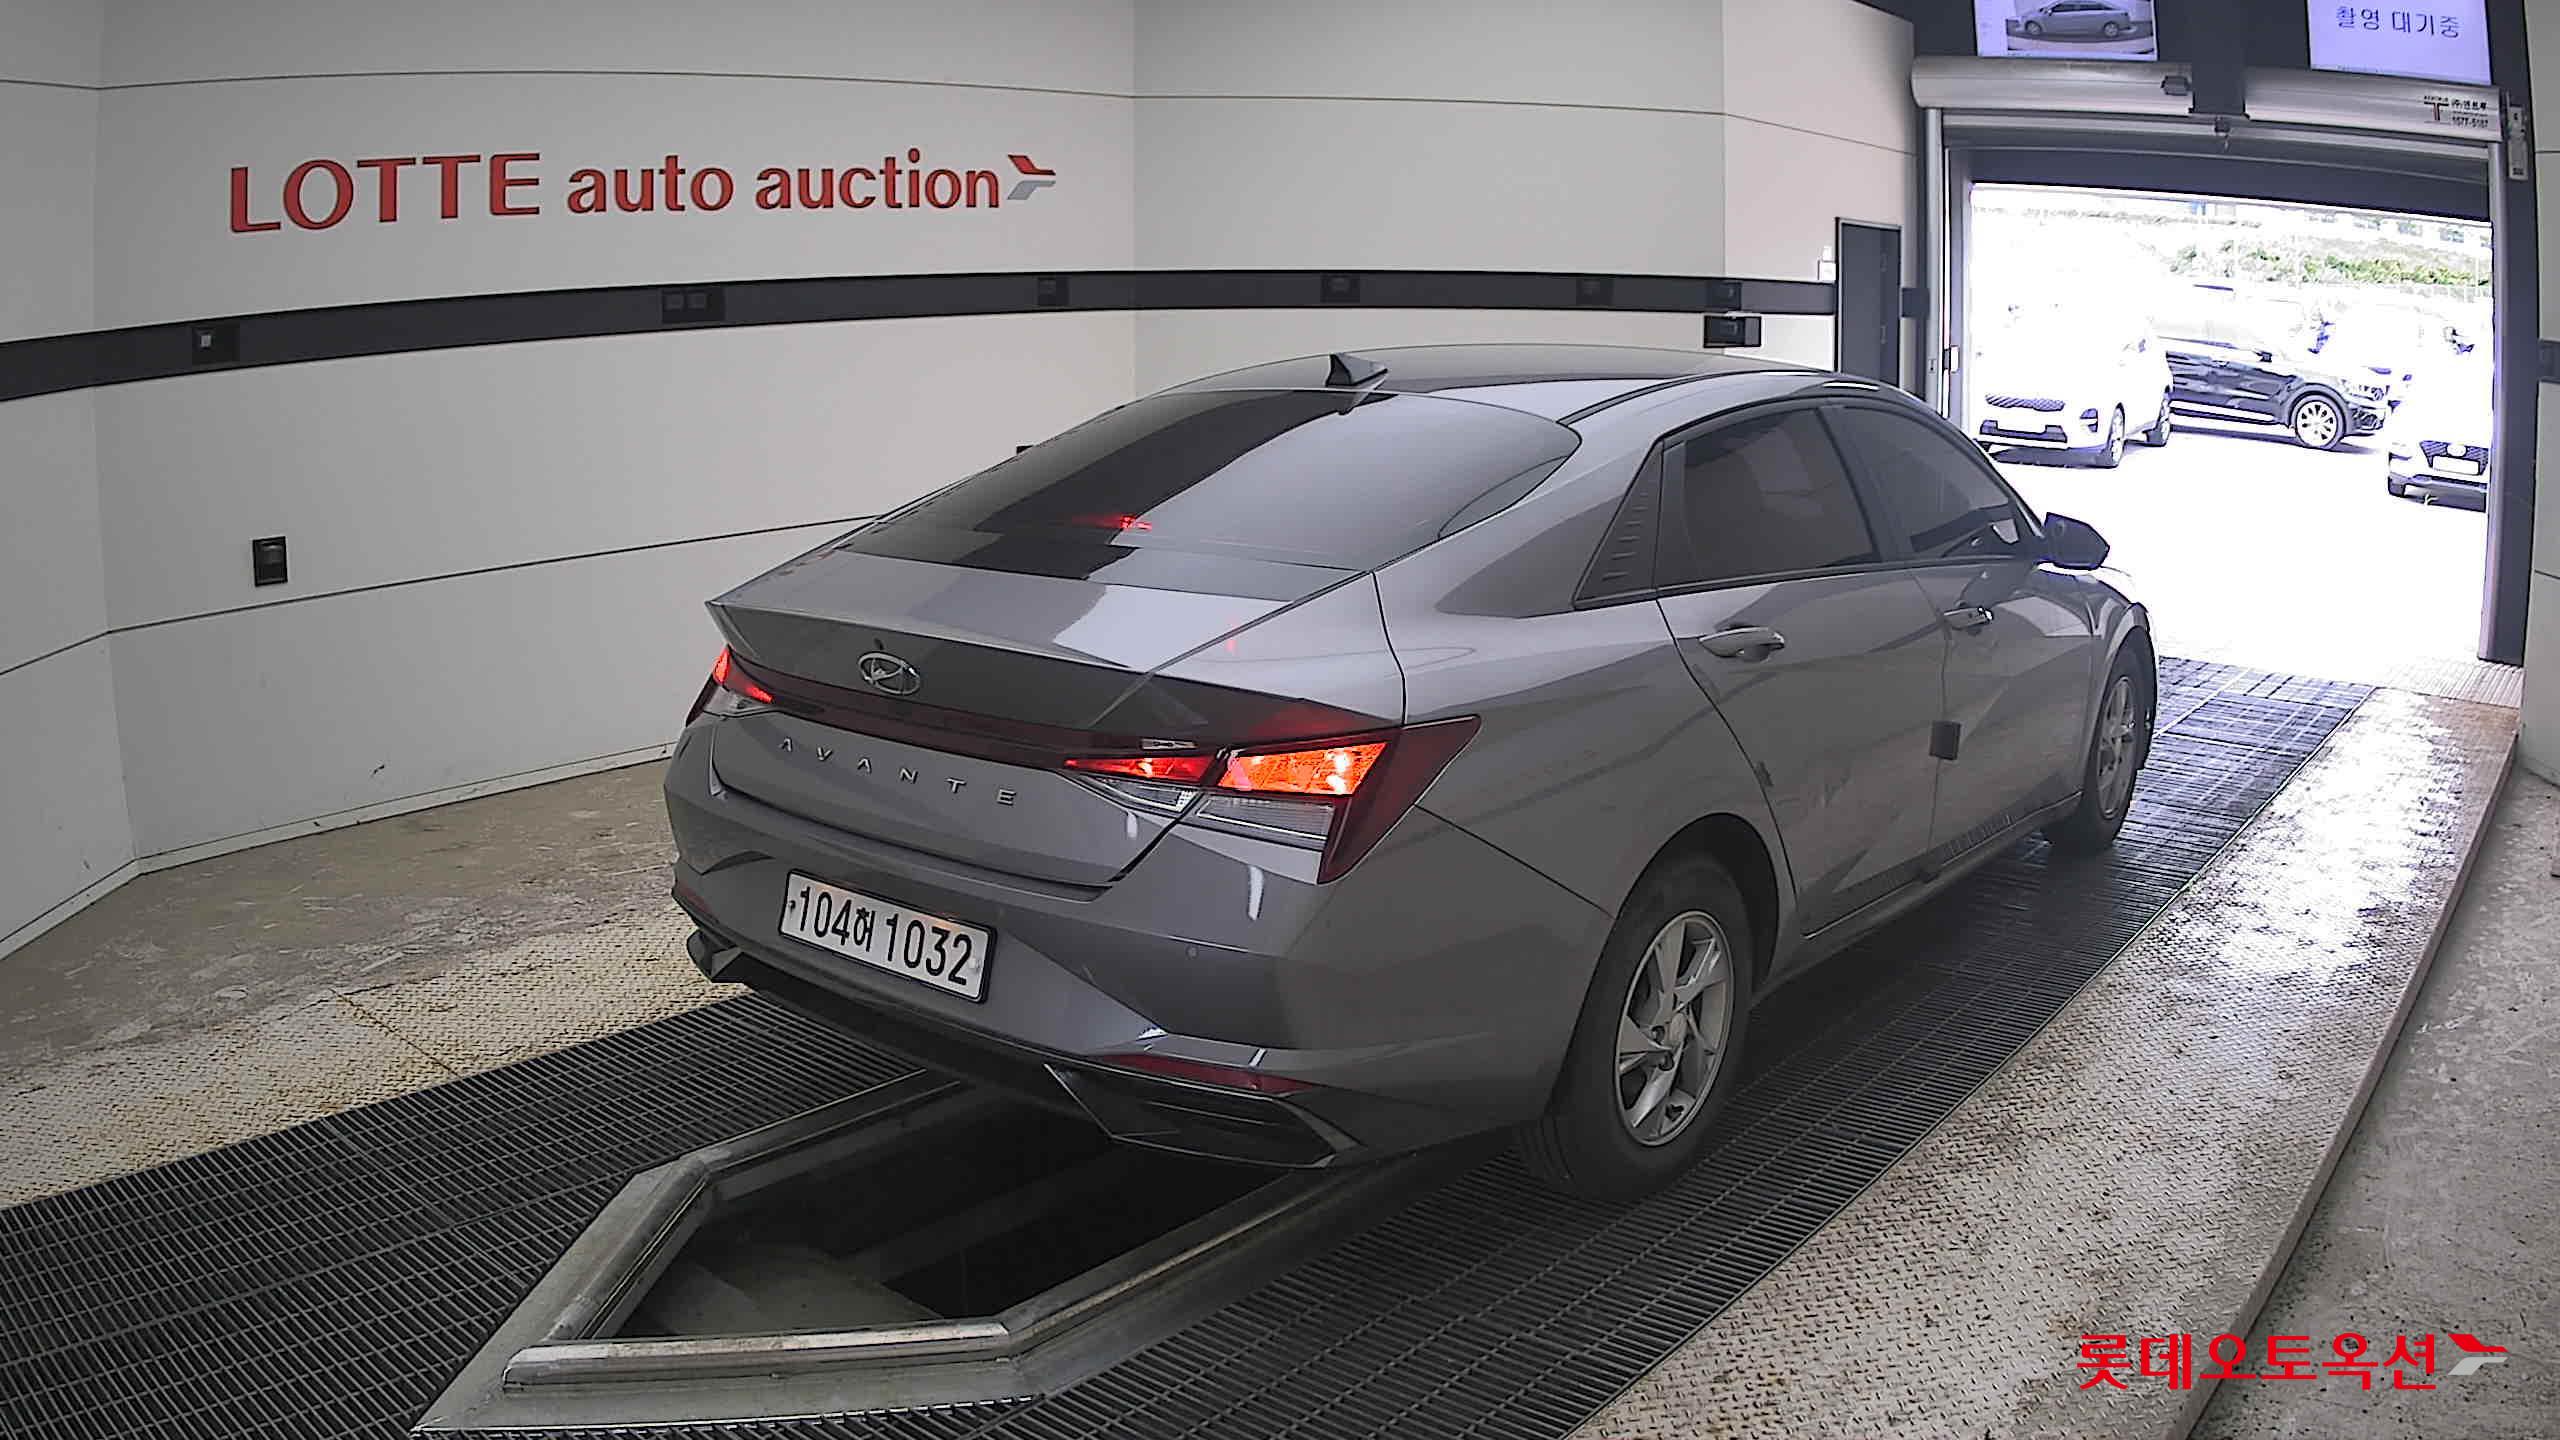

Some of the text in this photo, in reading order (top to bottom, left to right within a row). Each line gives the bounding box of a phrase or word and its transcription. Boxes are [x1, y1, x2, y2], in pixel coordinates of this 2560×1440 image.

[2336, 6, 2460, 39] 촬영 대기중
[230, 148, 1001, 233] LOTTE auto auction
[779, 736, 1017, 806] AVANTE
[800, 886, 973, 986] 104허 1032
